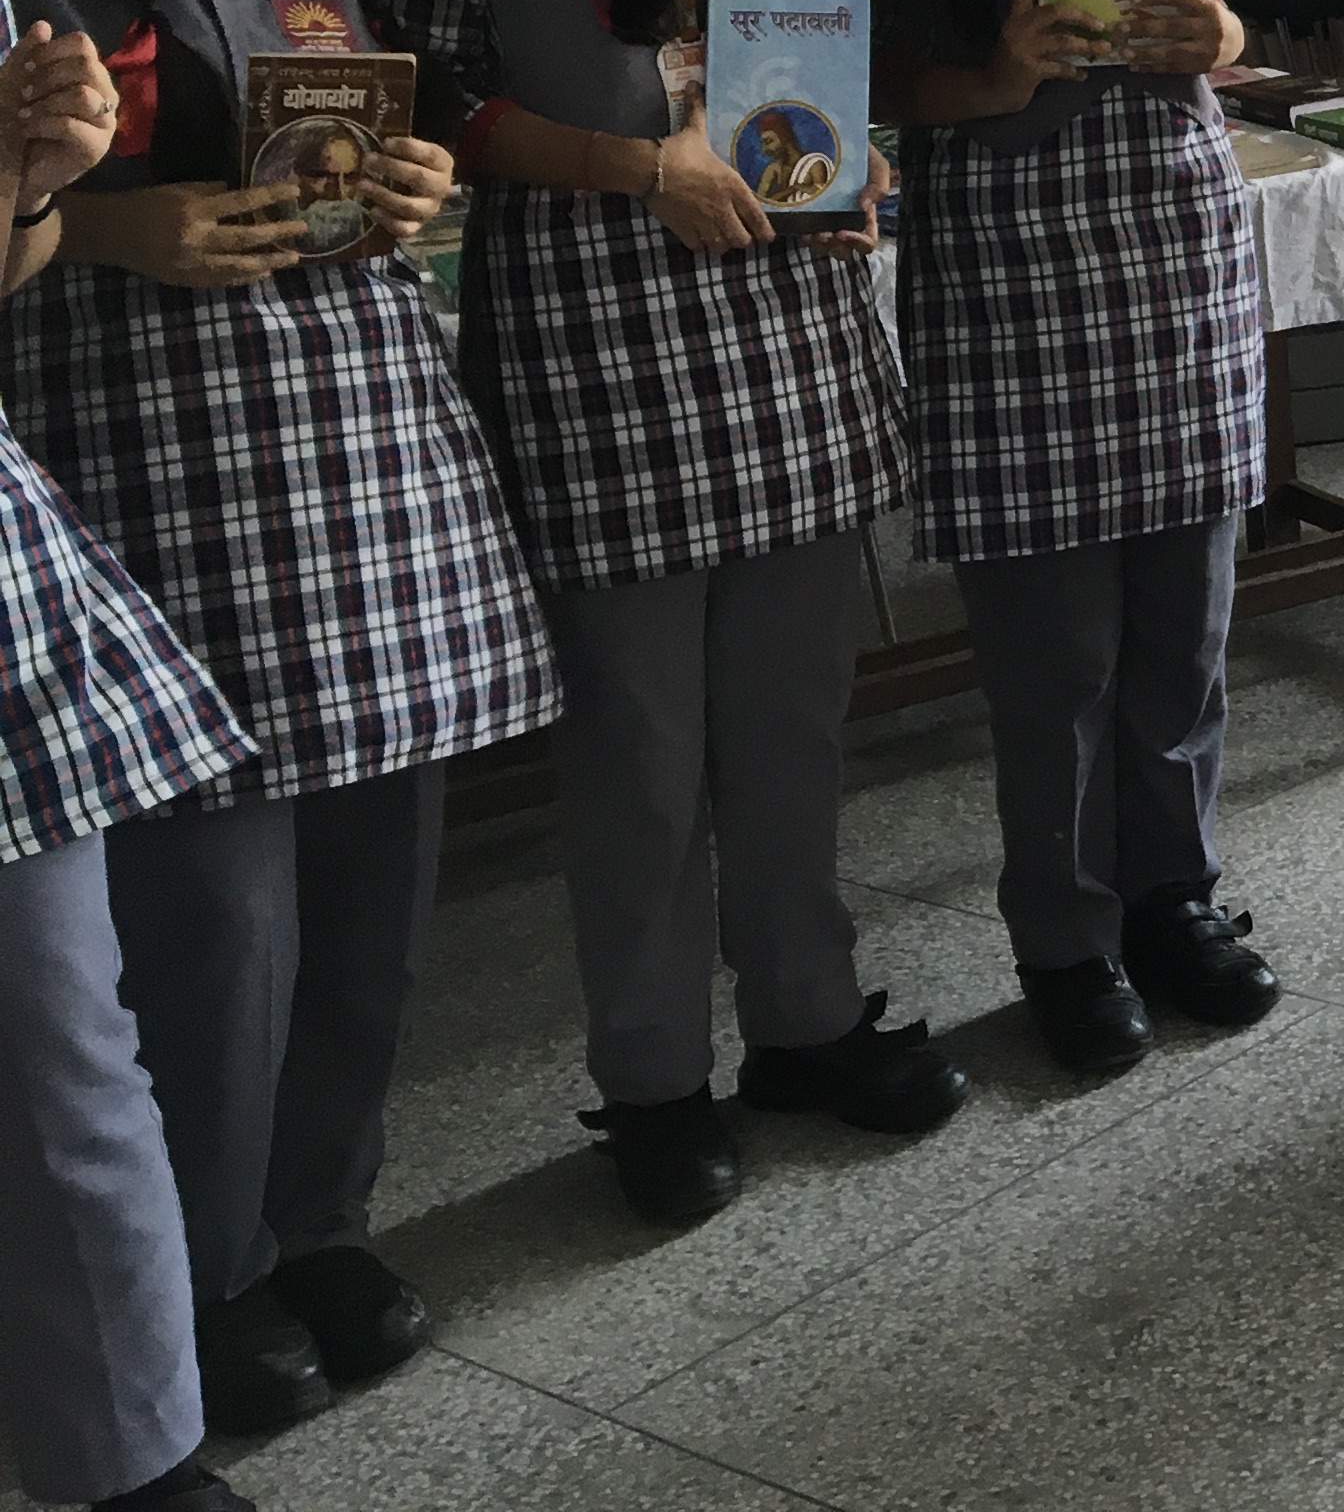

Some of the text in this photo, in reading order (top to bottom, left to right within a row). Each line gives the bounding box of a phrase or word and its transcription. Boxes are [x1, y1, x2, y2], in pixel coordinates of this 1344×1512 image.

[728, 5, 855, 42] सूर पदावली
[282, 84, 369, 111] योगायोग
